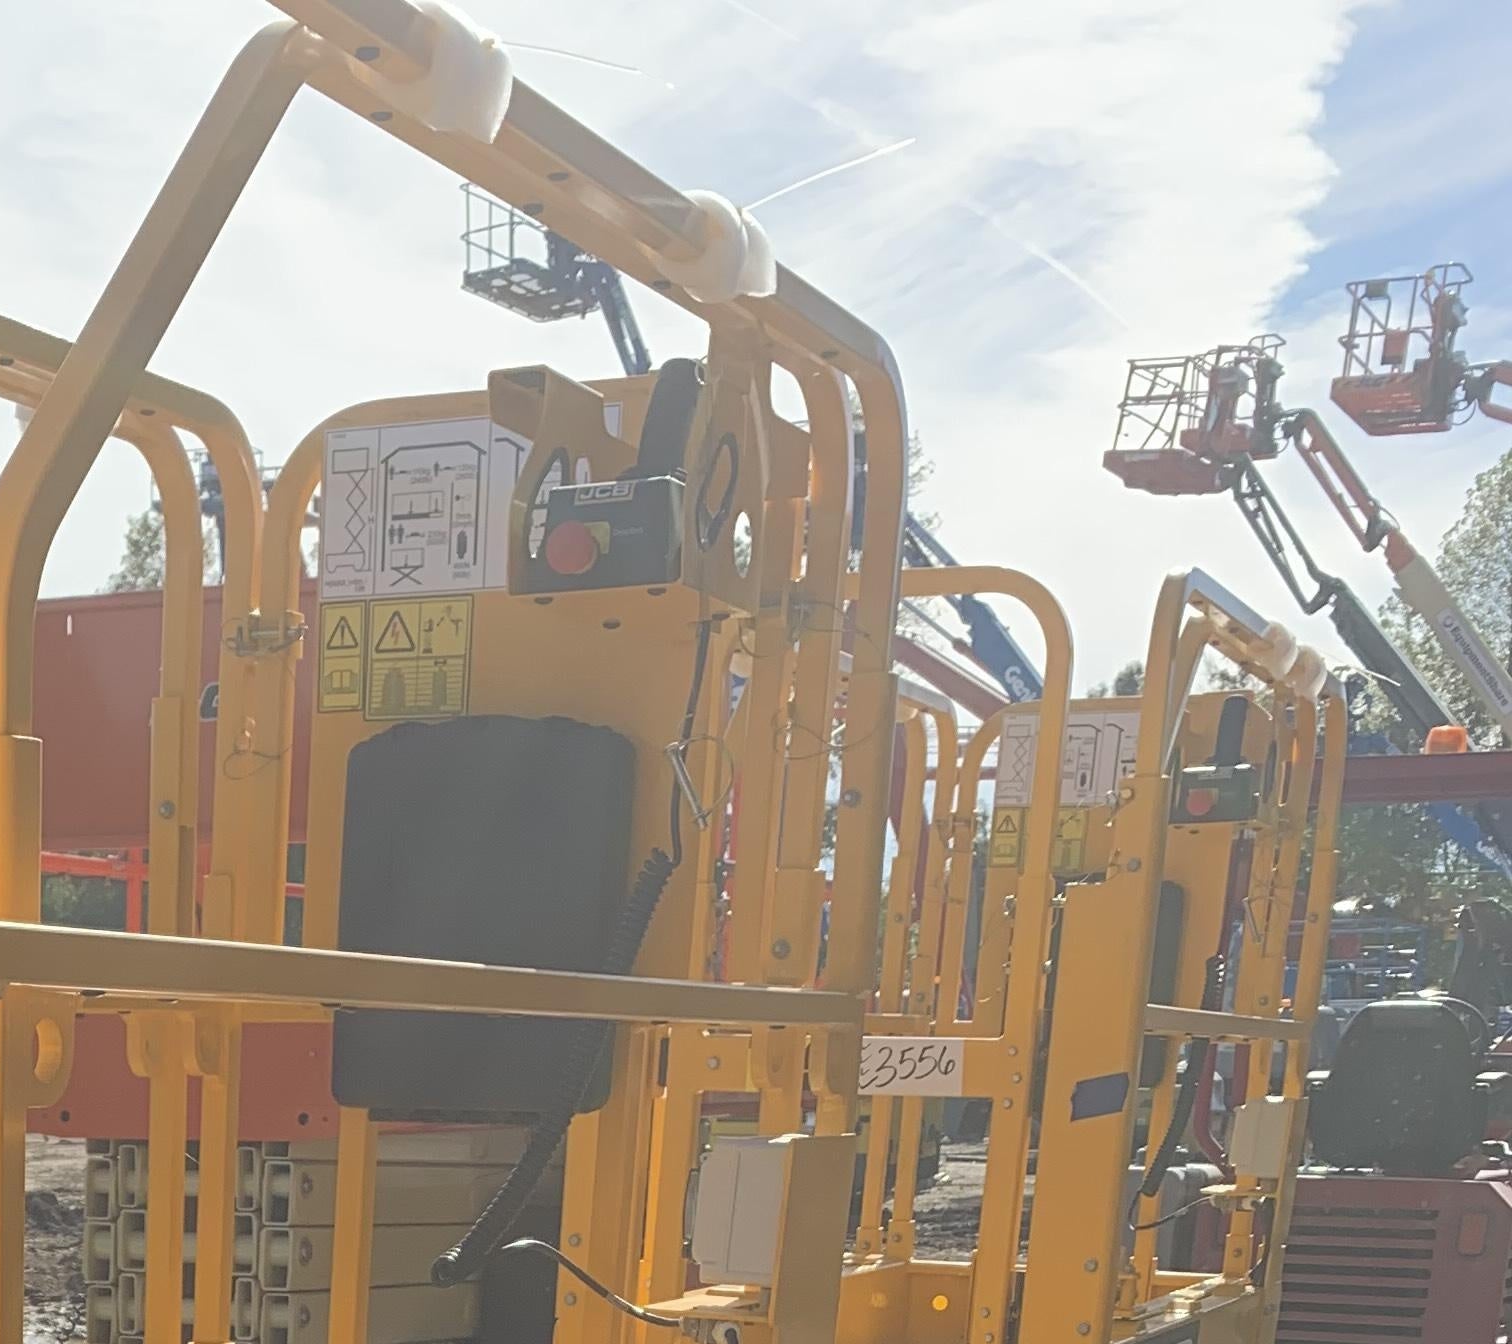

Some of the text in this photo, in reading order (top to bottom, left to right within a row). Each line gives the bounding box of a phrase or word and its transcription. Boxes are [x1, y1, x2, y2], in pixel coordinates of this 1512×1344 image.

[580, 483, 630, 500] JCB
[1450, 626, 1509, 706] EquipmentShare
[874, 1045, 956, 1088] 3556
